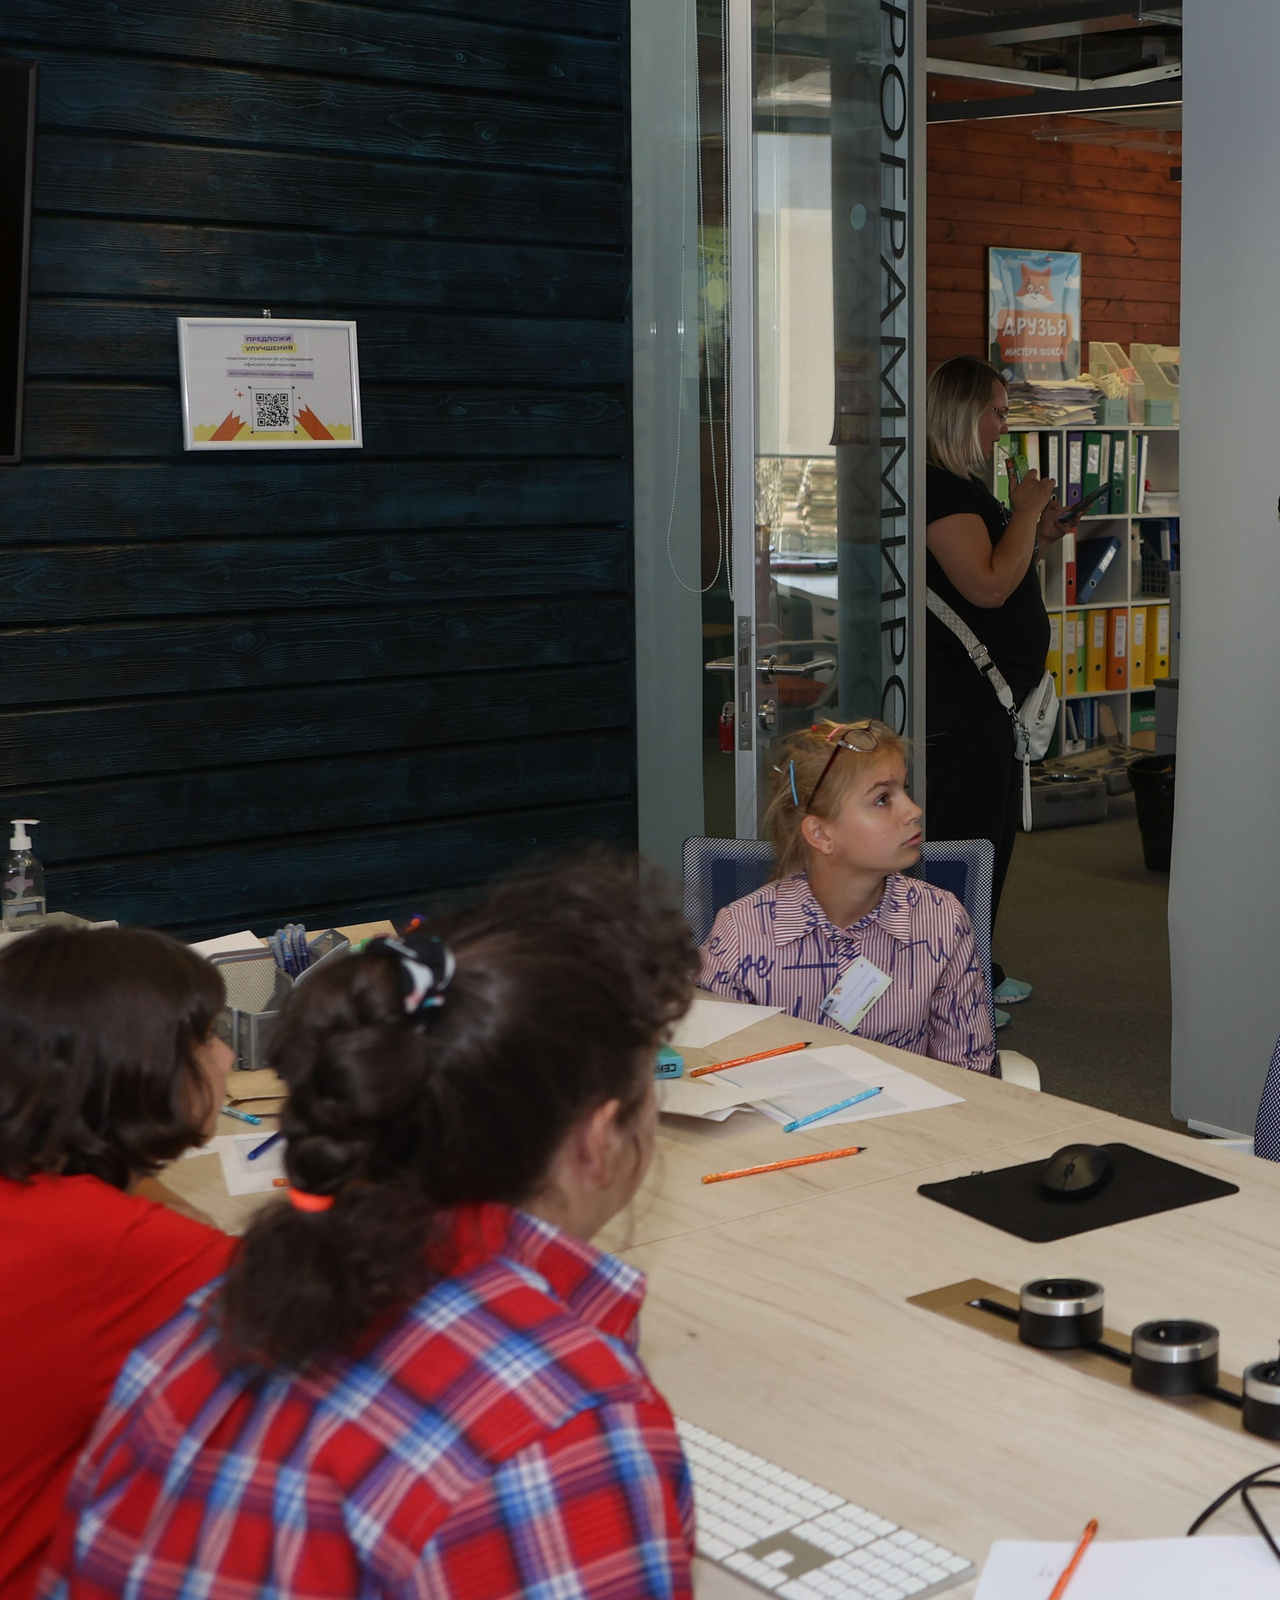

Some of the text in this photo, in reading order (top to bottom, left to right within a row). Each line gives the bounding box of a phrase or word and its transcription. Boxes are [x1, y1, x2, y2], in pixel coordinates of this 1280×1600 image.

[1002, 316, 1067, 338] ДРУЗЬЯ
[1004, 347, 1065, 357] МИСТЕРА ФОКСА
